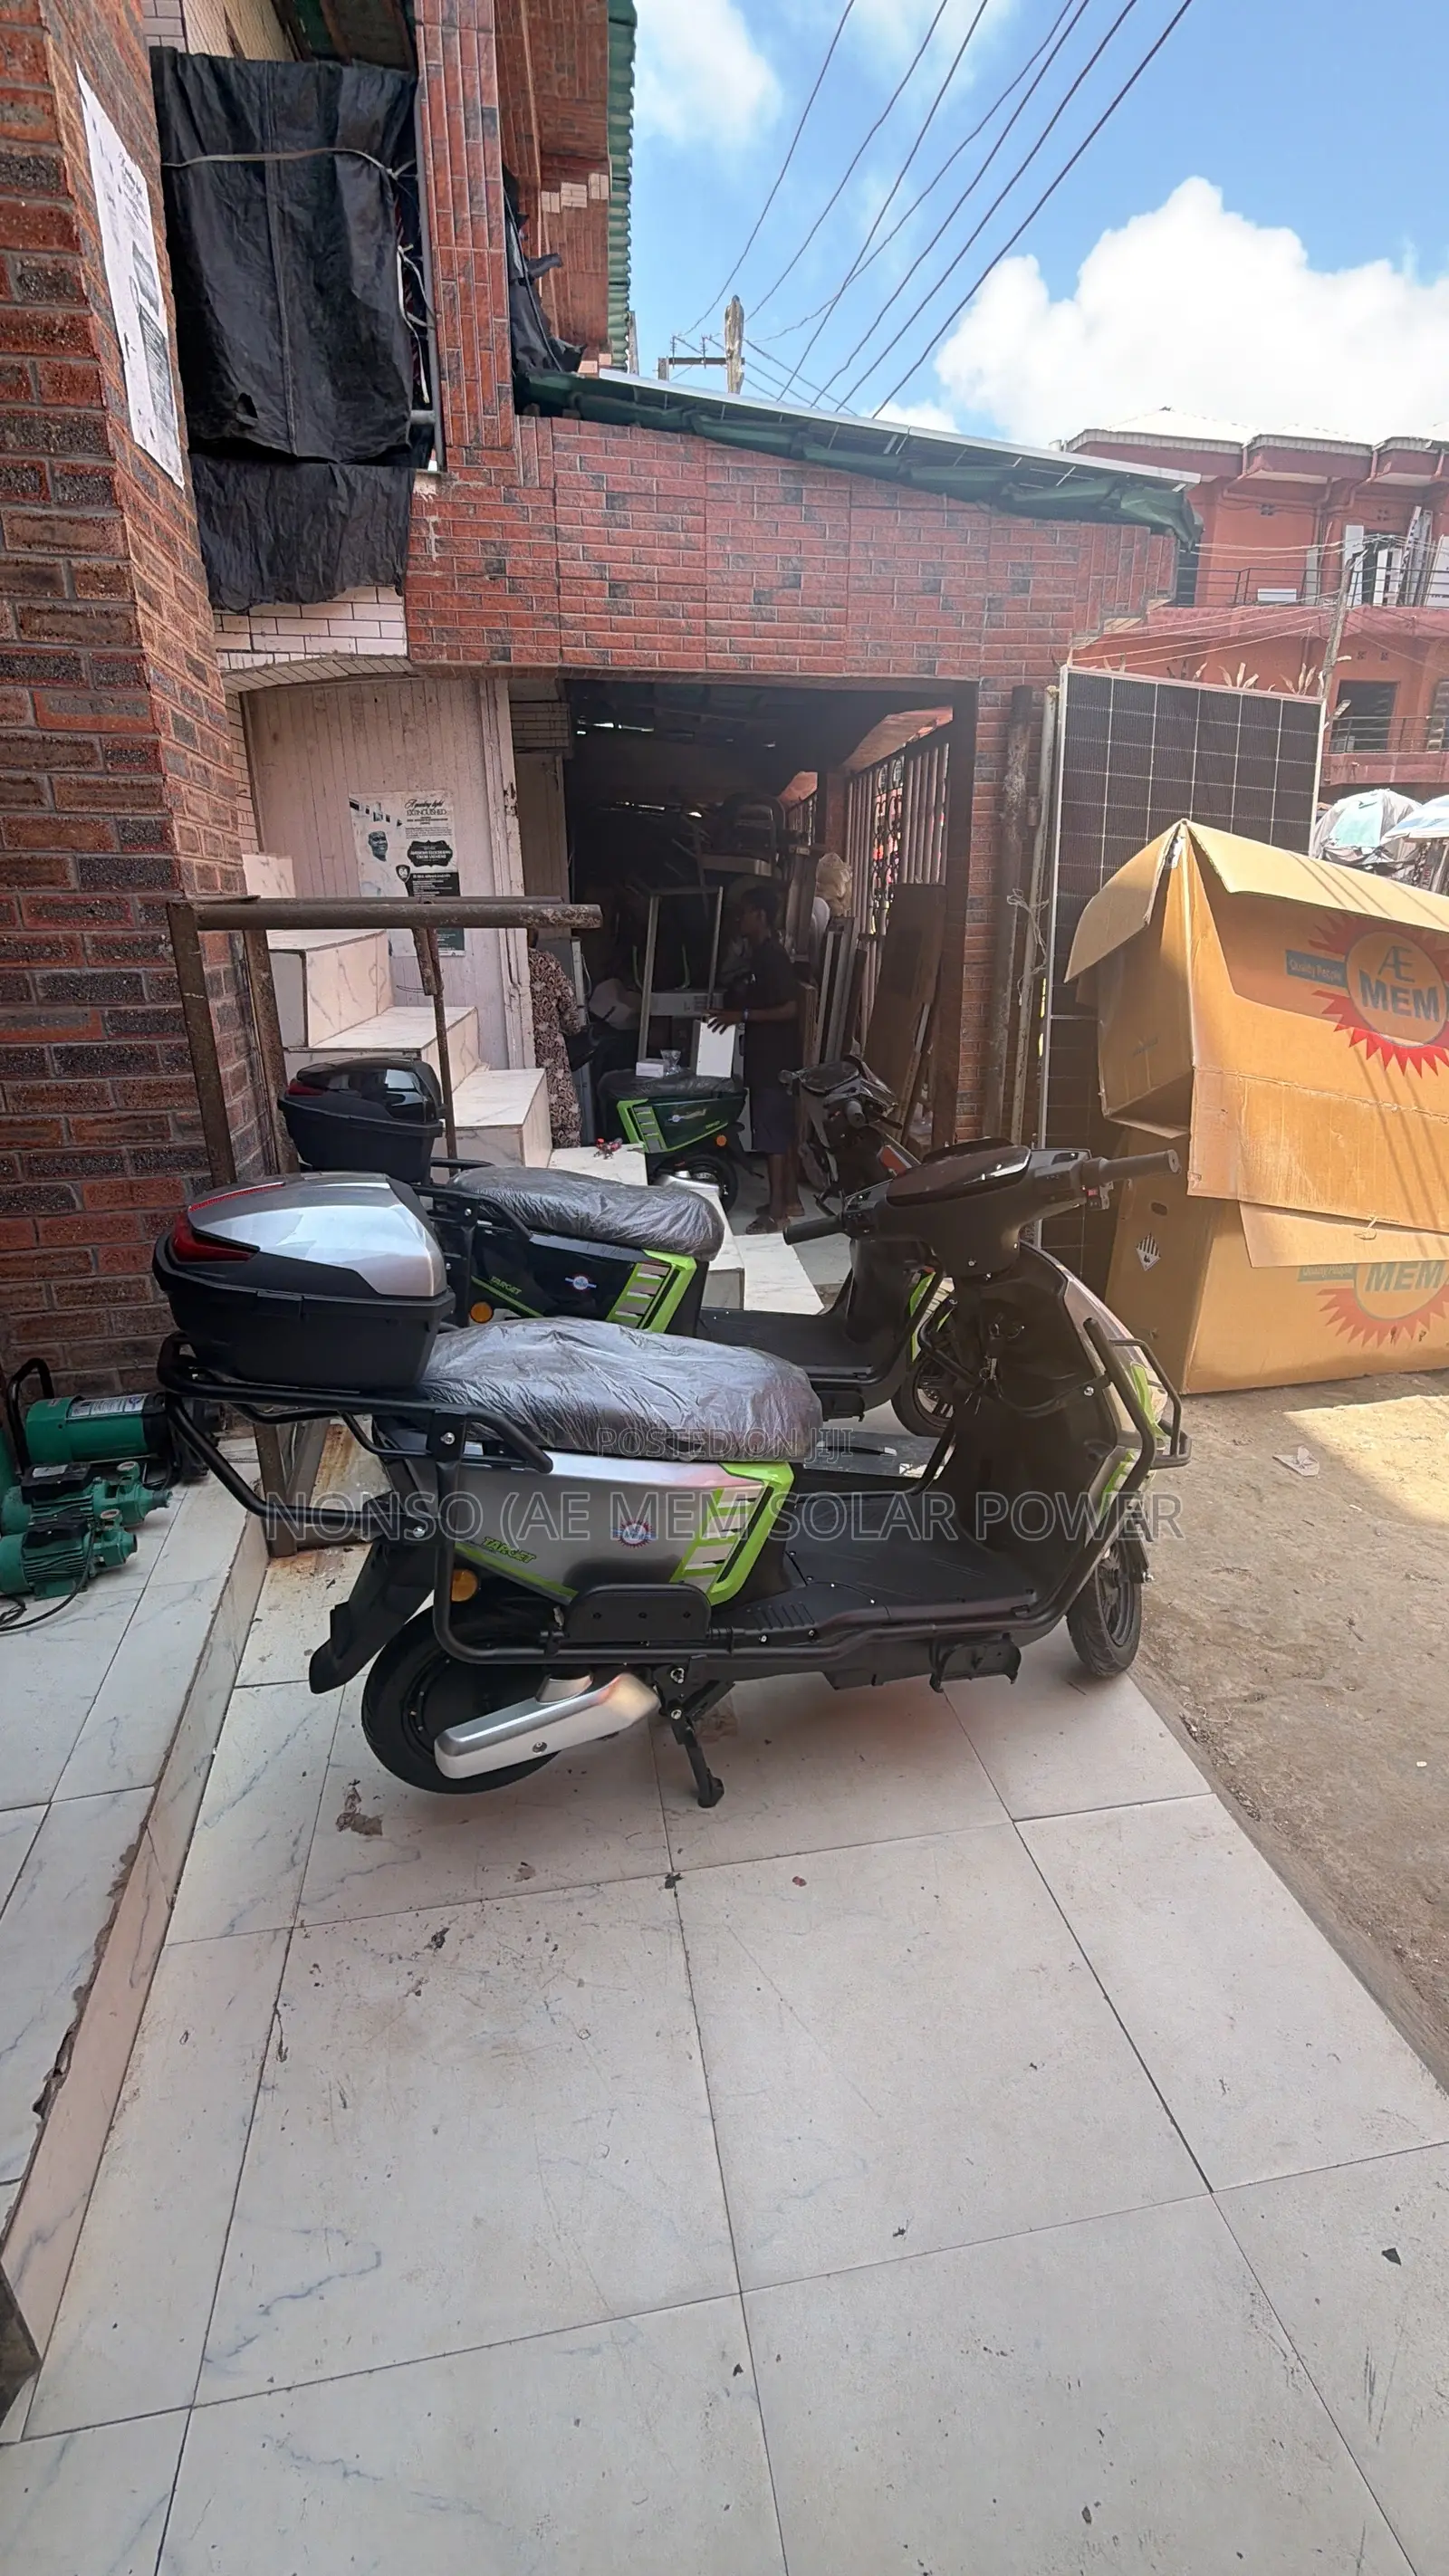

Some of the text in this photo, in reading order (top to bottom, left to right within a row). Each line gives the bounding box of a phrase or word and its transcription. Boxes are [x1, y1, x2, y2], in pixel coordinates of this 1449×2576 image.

[1359, 969, 1440, 1022] MEM
[1364, 1260, 1446, 1292] MEM
[482, 1537, 536, 1563] TARGET
